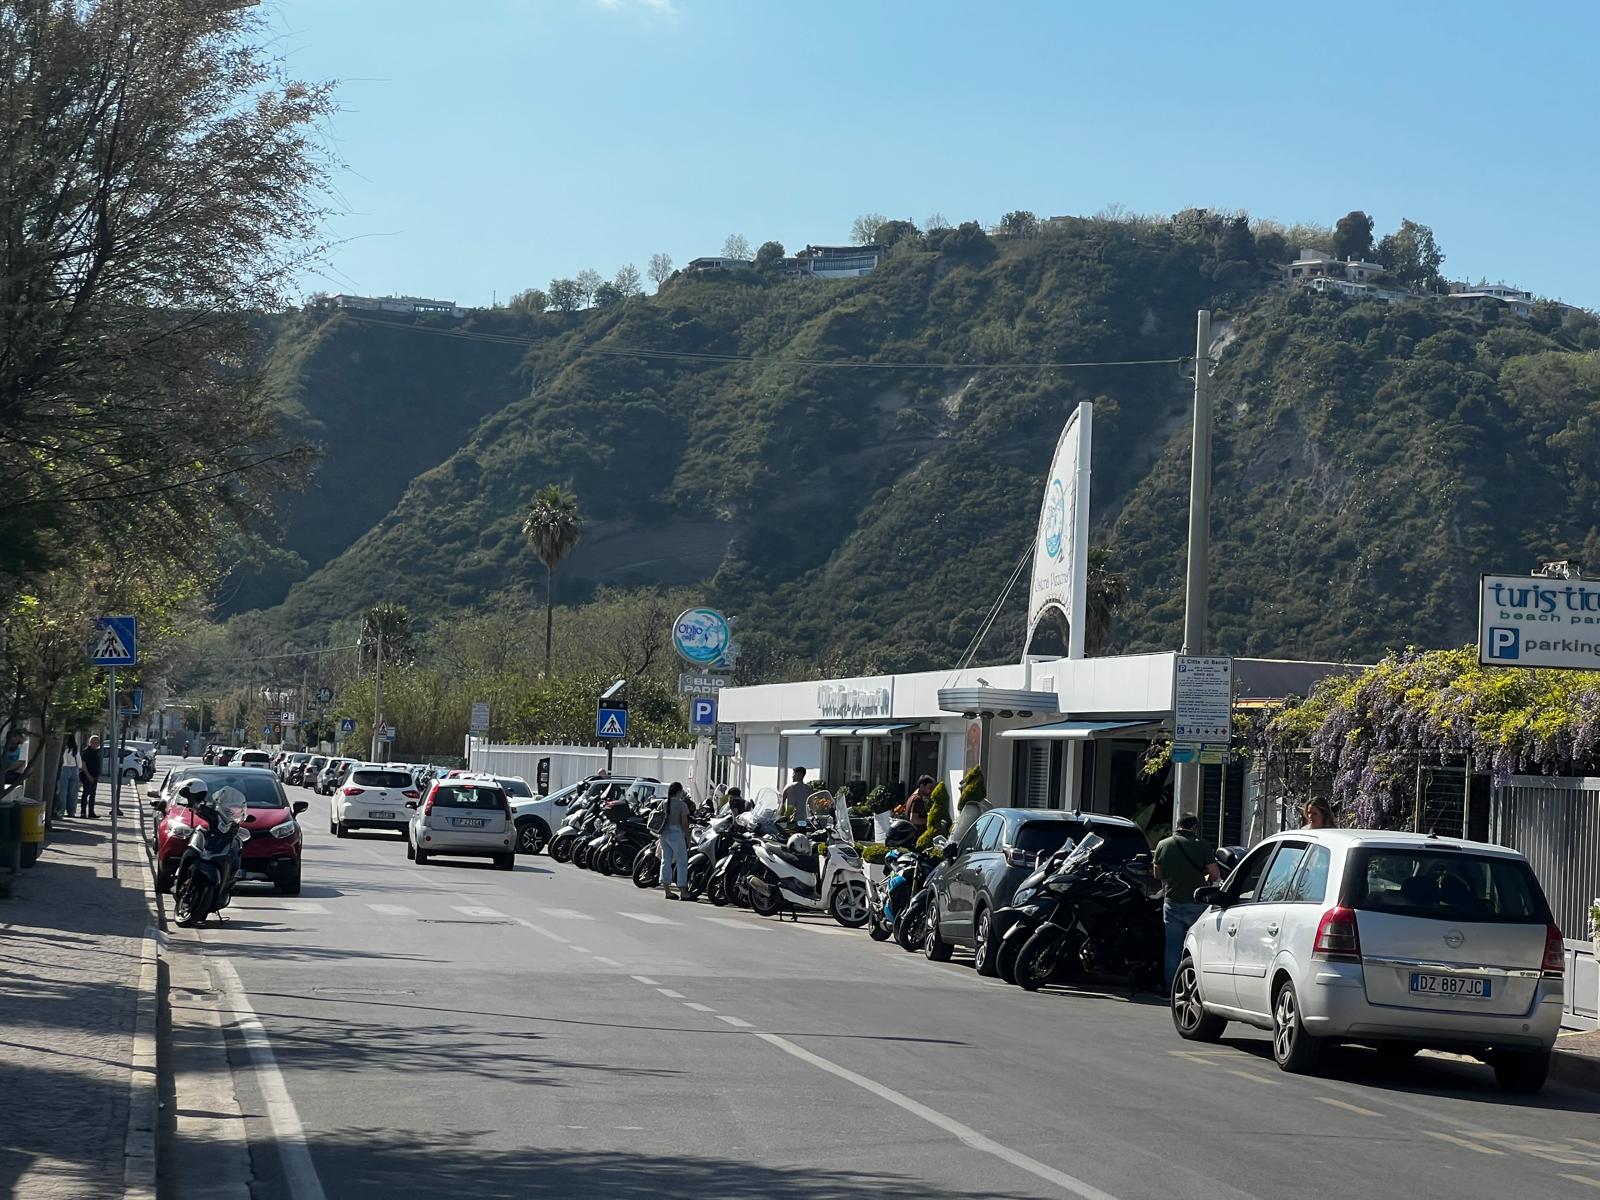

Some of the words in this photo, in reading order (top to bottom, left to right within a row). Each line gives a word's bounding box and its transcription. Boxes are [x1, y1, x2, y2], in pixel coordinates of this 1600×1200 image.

[1500, 610, 1561, 622] beach
[1493, 628, 1515, 657] P
[1525, 639, 1600, 656] parking
[684, 685, 719, 694] PADE
[696, 702, 712, 722] P
[1420, 975, 1436, 991] DZ
